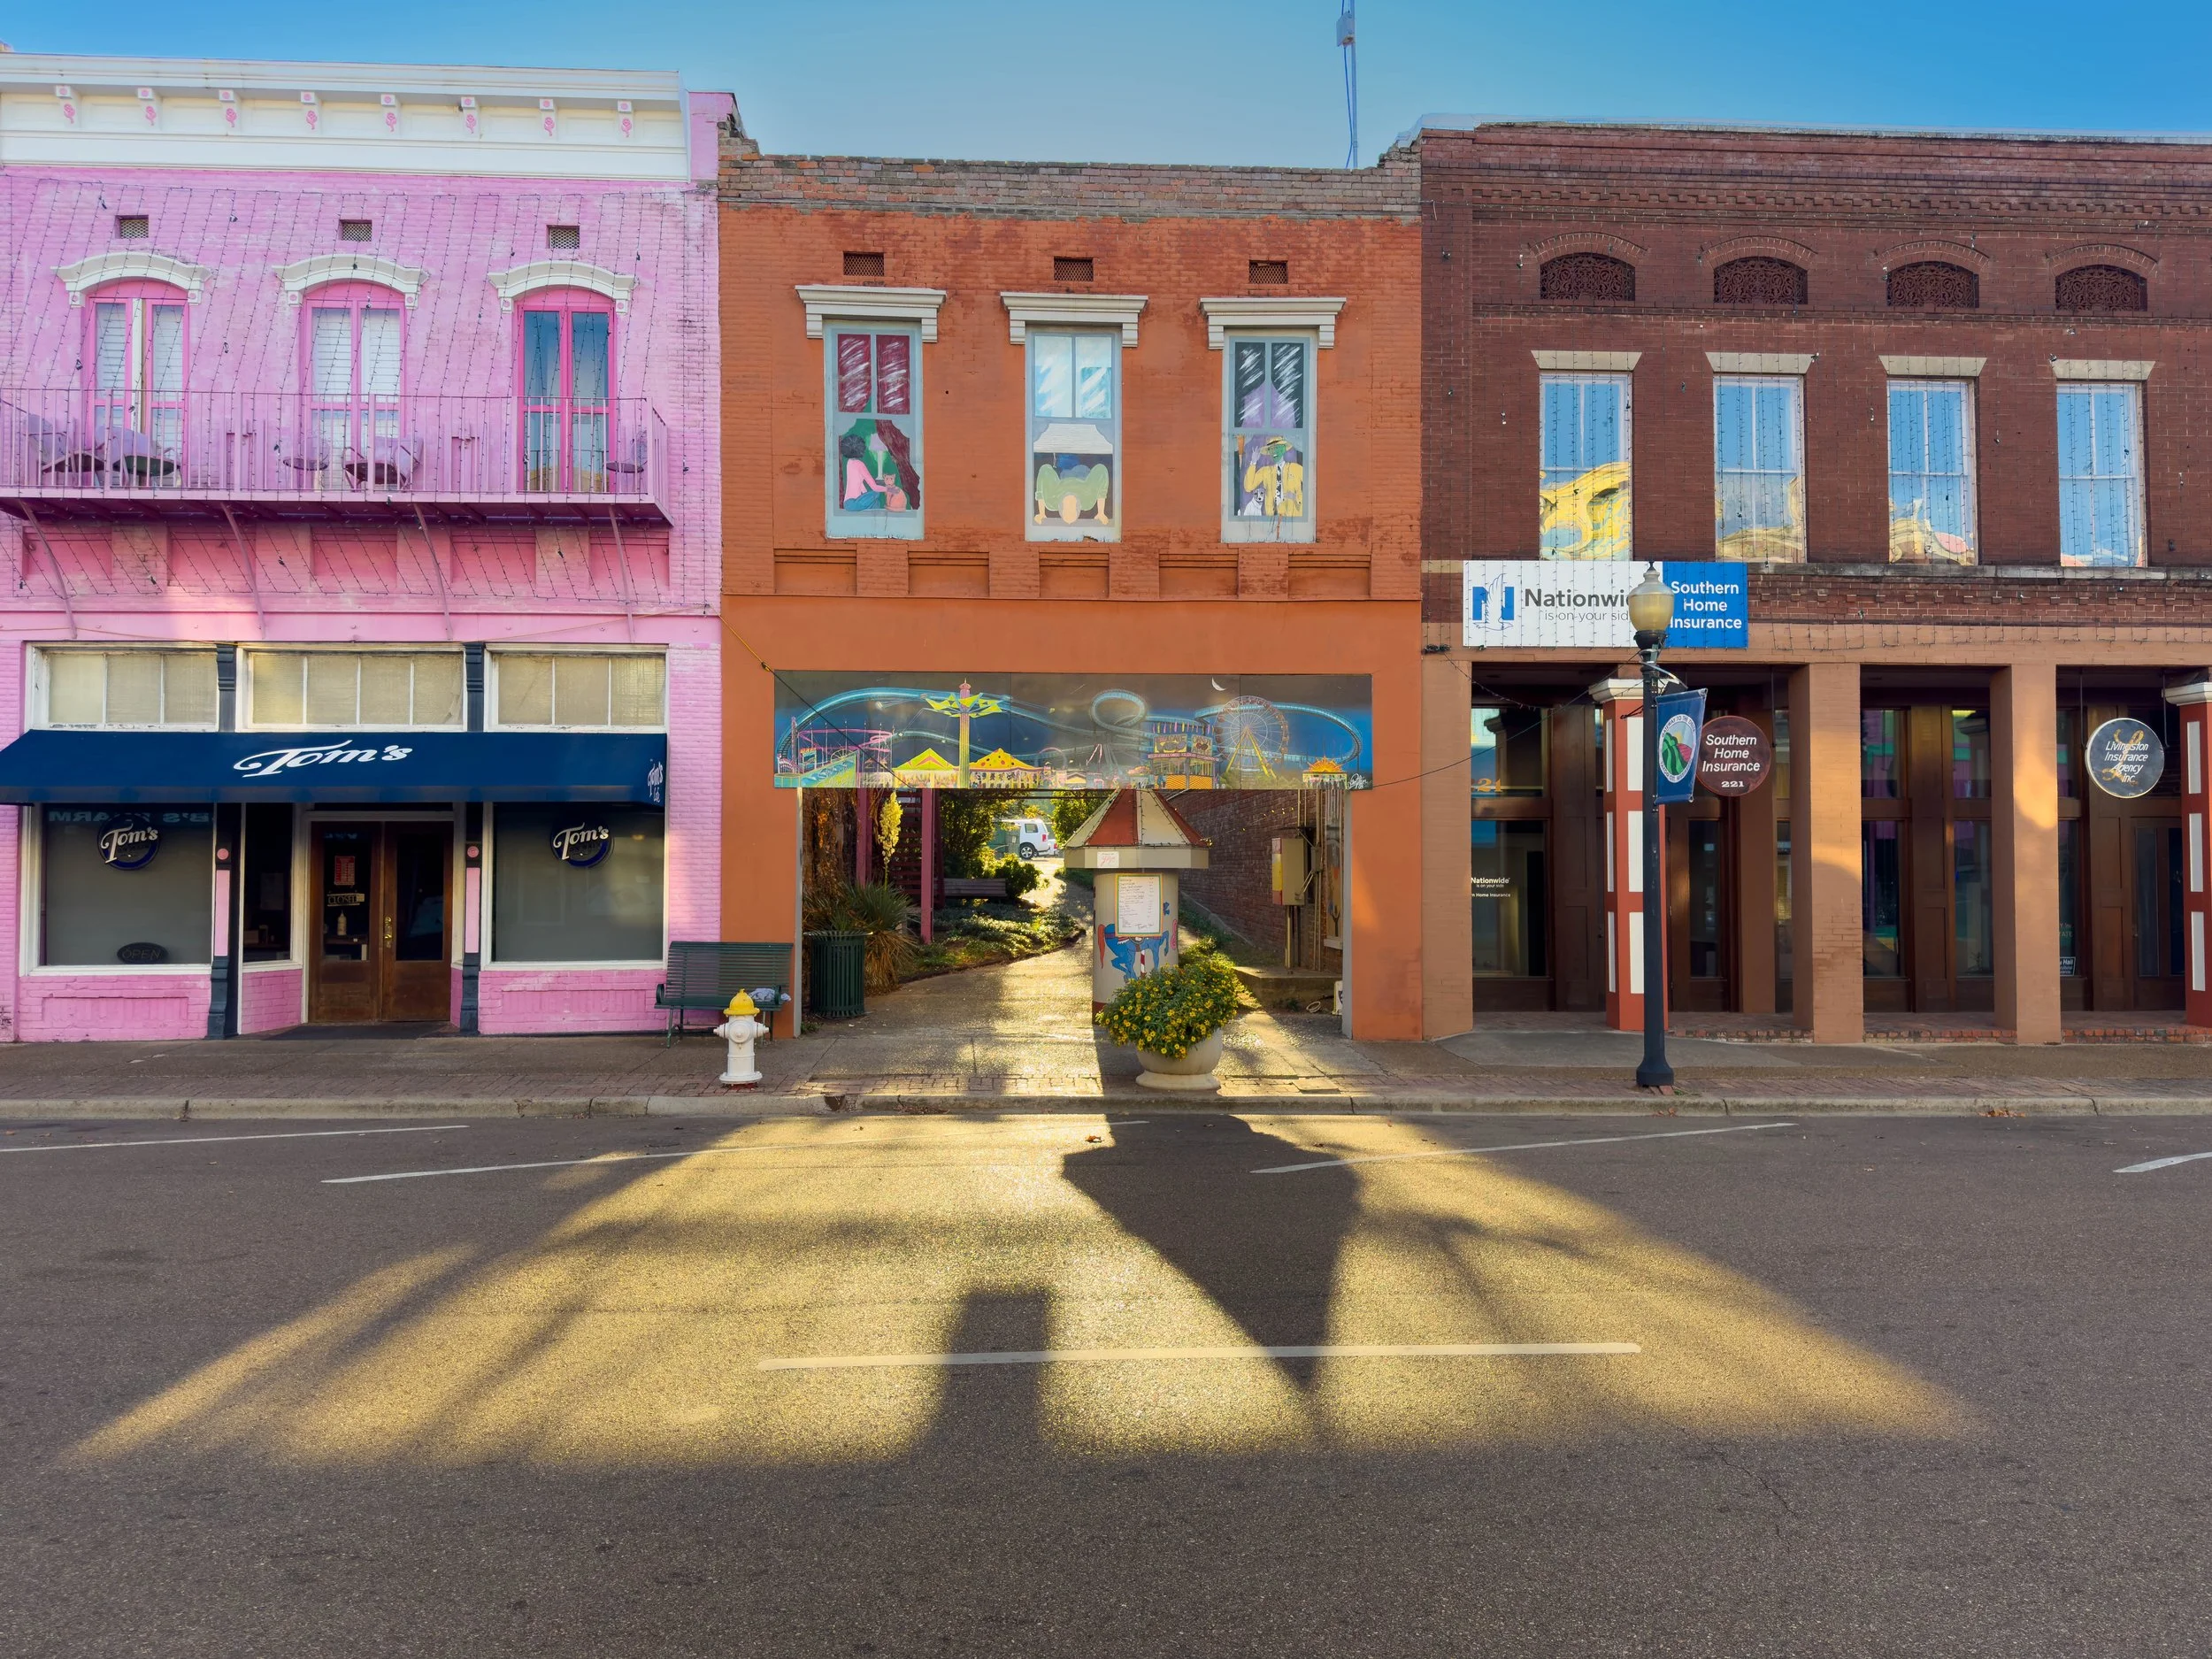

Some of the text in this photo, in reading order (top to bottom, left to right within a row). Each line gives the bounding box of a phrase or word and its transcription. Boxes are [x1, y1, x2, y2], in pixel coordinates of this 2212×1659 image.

[1671, 580, 1740, 594] Southern
[1525, 588, 1629, 607] Nationwi
[1684, 598, 1728, 611] Home
[1545, 611, 1629, 622] is on your sid
[1670, 616, 1742, 629] Insurance
[1705, 734, 1757, 746] Southern
[2106, 741, 2149, 752] Livingston
[233, 740, 413, 778] Tom's
[1714, 748, 1749, 759] Home
[2105, 752, 2149, 762] Insurance
[1701, 761, 1761, 772] Insurance
[2109, 762, 2144, 775] Agency
[100, 823, 159, 864] Tom's
[553, 822, 610, 860] Tom's
[122, 948, 161, 960] OPEN
